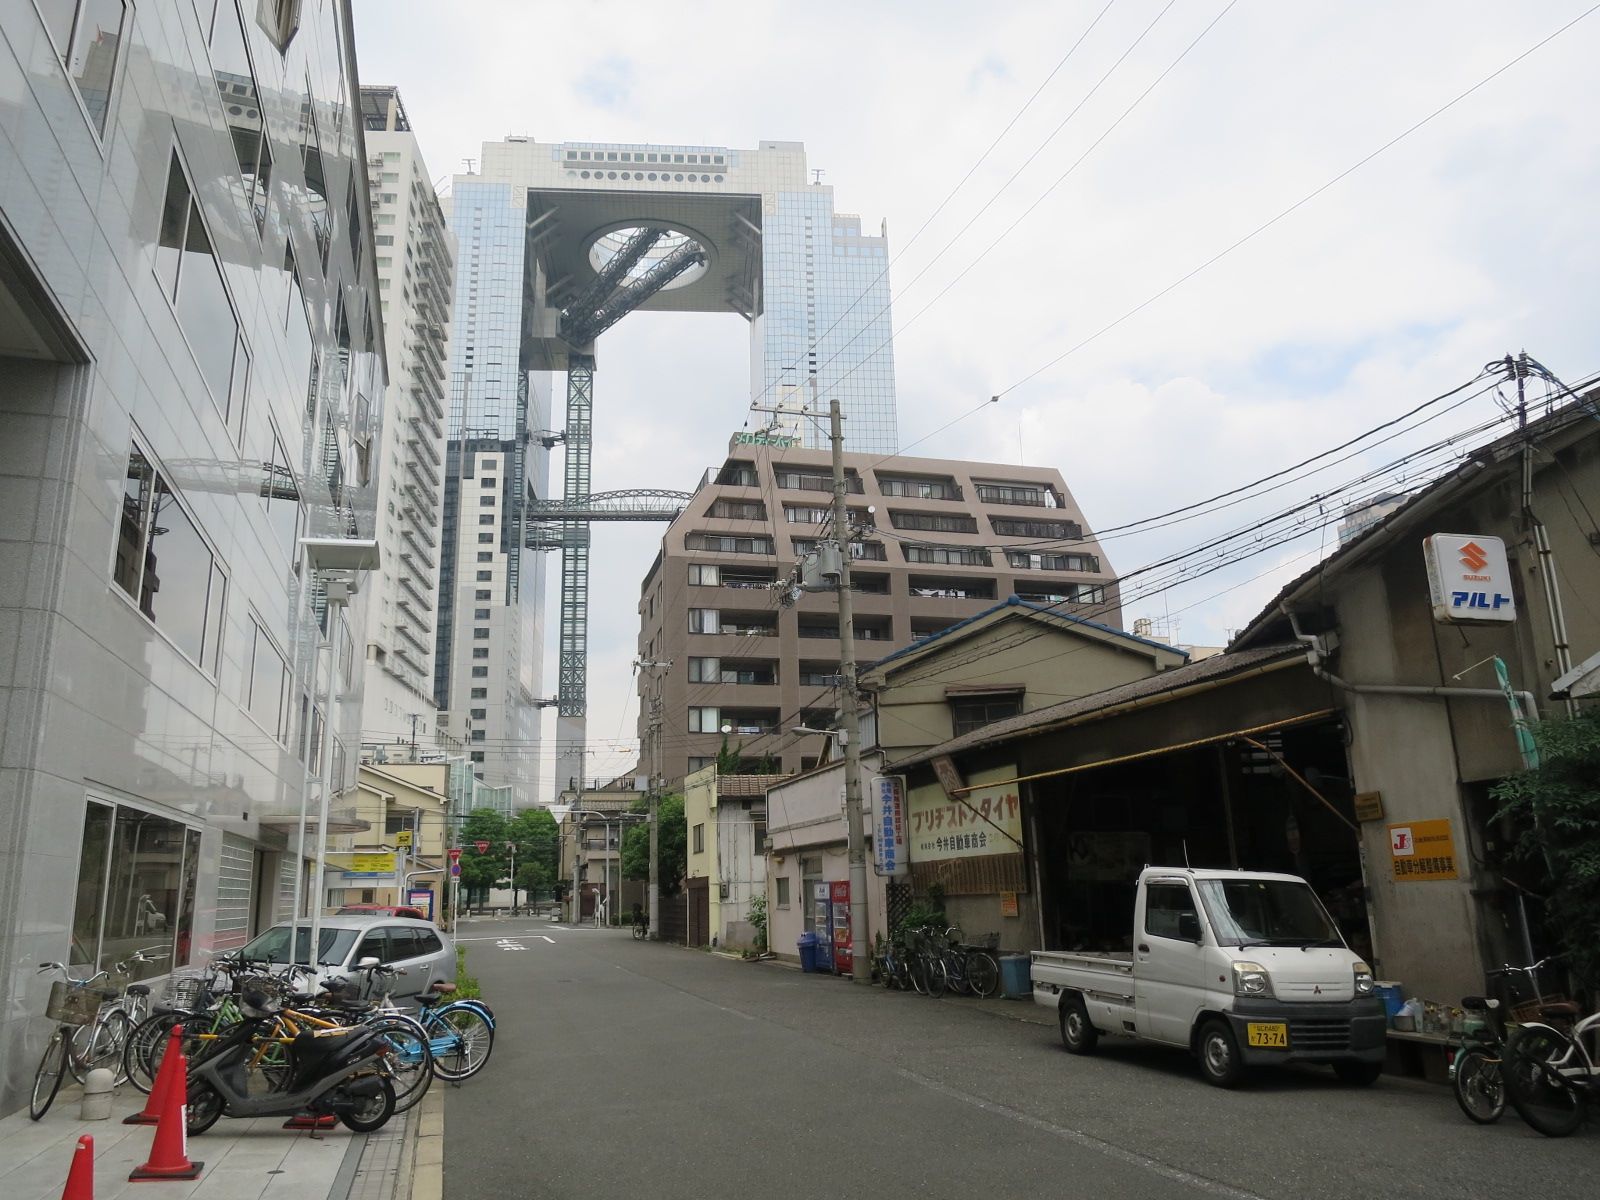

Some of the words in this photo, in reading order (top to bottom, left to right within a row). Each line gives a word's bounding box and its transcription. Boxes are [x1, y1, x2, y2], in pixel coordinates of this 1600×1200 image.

[1452, 591, 1510, 609] アルト
[912, 793, 1018, 833] ブリヂストンタイヤ
[881, 795, 896, 871] 今井自動車商会
[936, 831, 987, 852] 今井自動車商会
